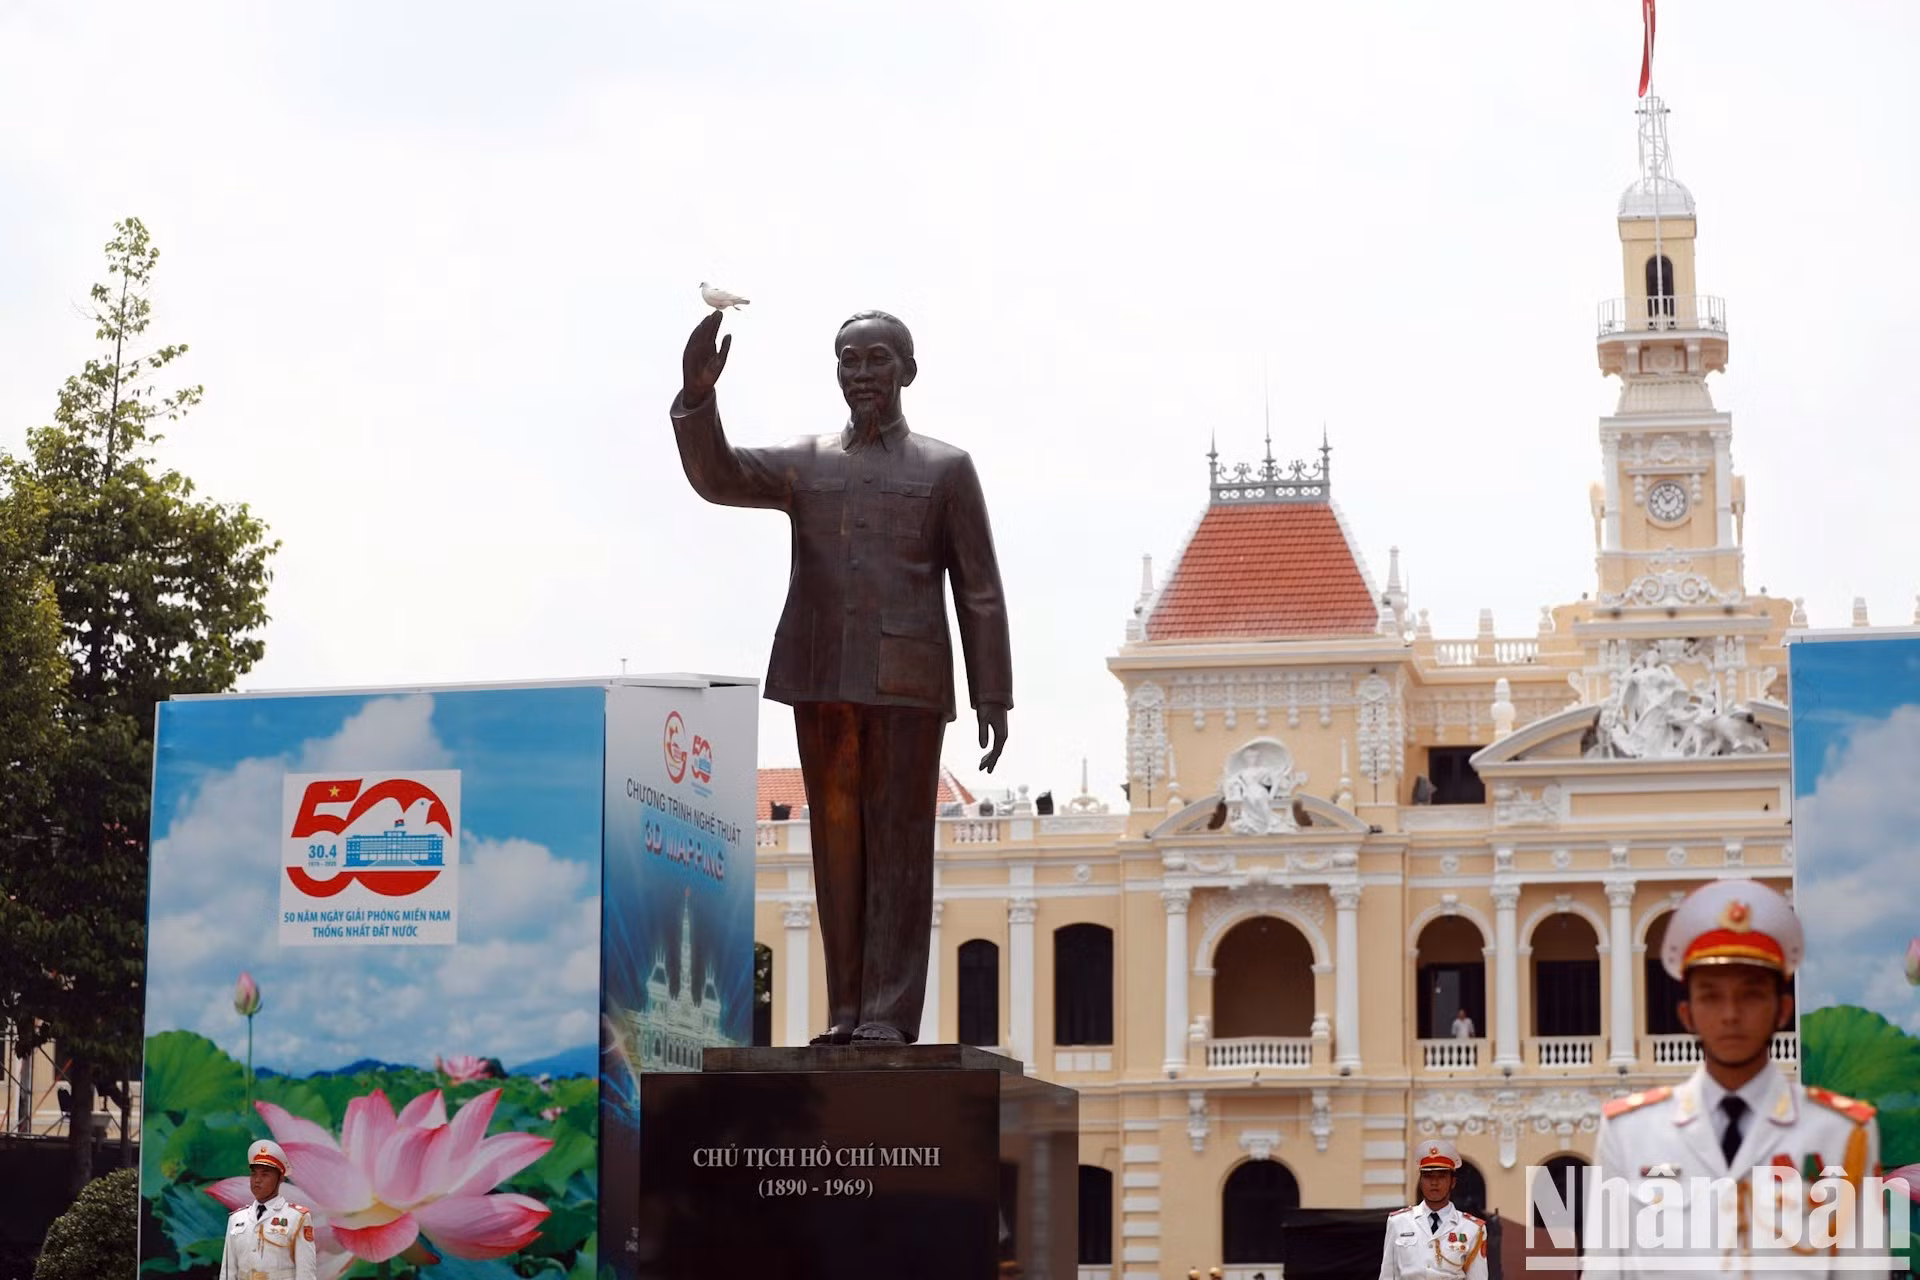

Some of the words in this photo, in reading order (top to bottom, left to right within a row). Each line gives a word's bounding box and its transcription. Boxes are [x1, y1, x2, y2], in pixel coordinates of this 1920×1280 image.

[626, 778, 666, 812] CHƯƠNG
[308, 845, 337, 858] 30.4
[284, 912, 295, 923] 50
[320, 909, 343, 922] NGÀY
[367, 908, 400, 922] PHÓNG
[429, 910, 451, 921] NAM
[312, 924, 343, 938] THỐNG
[693, 1143, 738, 1168] CHỦ
[743, 1148, 795, 1170] TỊCH
[800, 1140, 832, 1167] HỒ
[835, 1142, 875, 1167] CHÍ
[880, 1147, 941, 1167] MINH
[758, 1178, 807, 1199] (1890
[823, 1178, 874, 1199] 1969)
